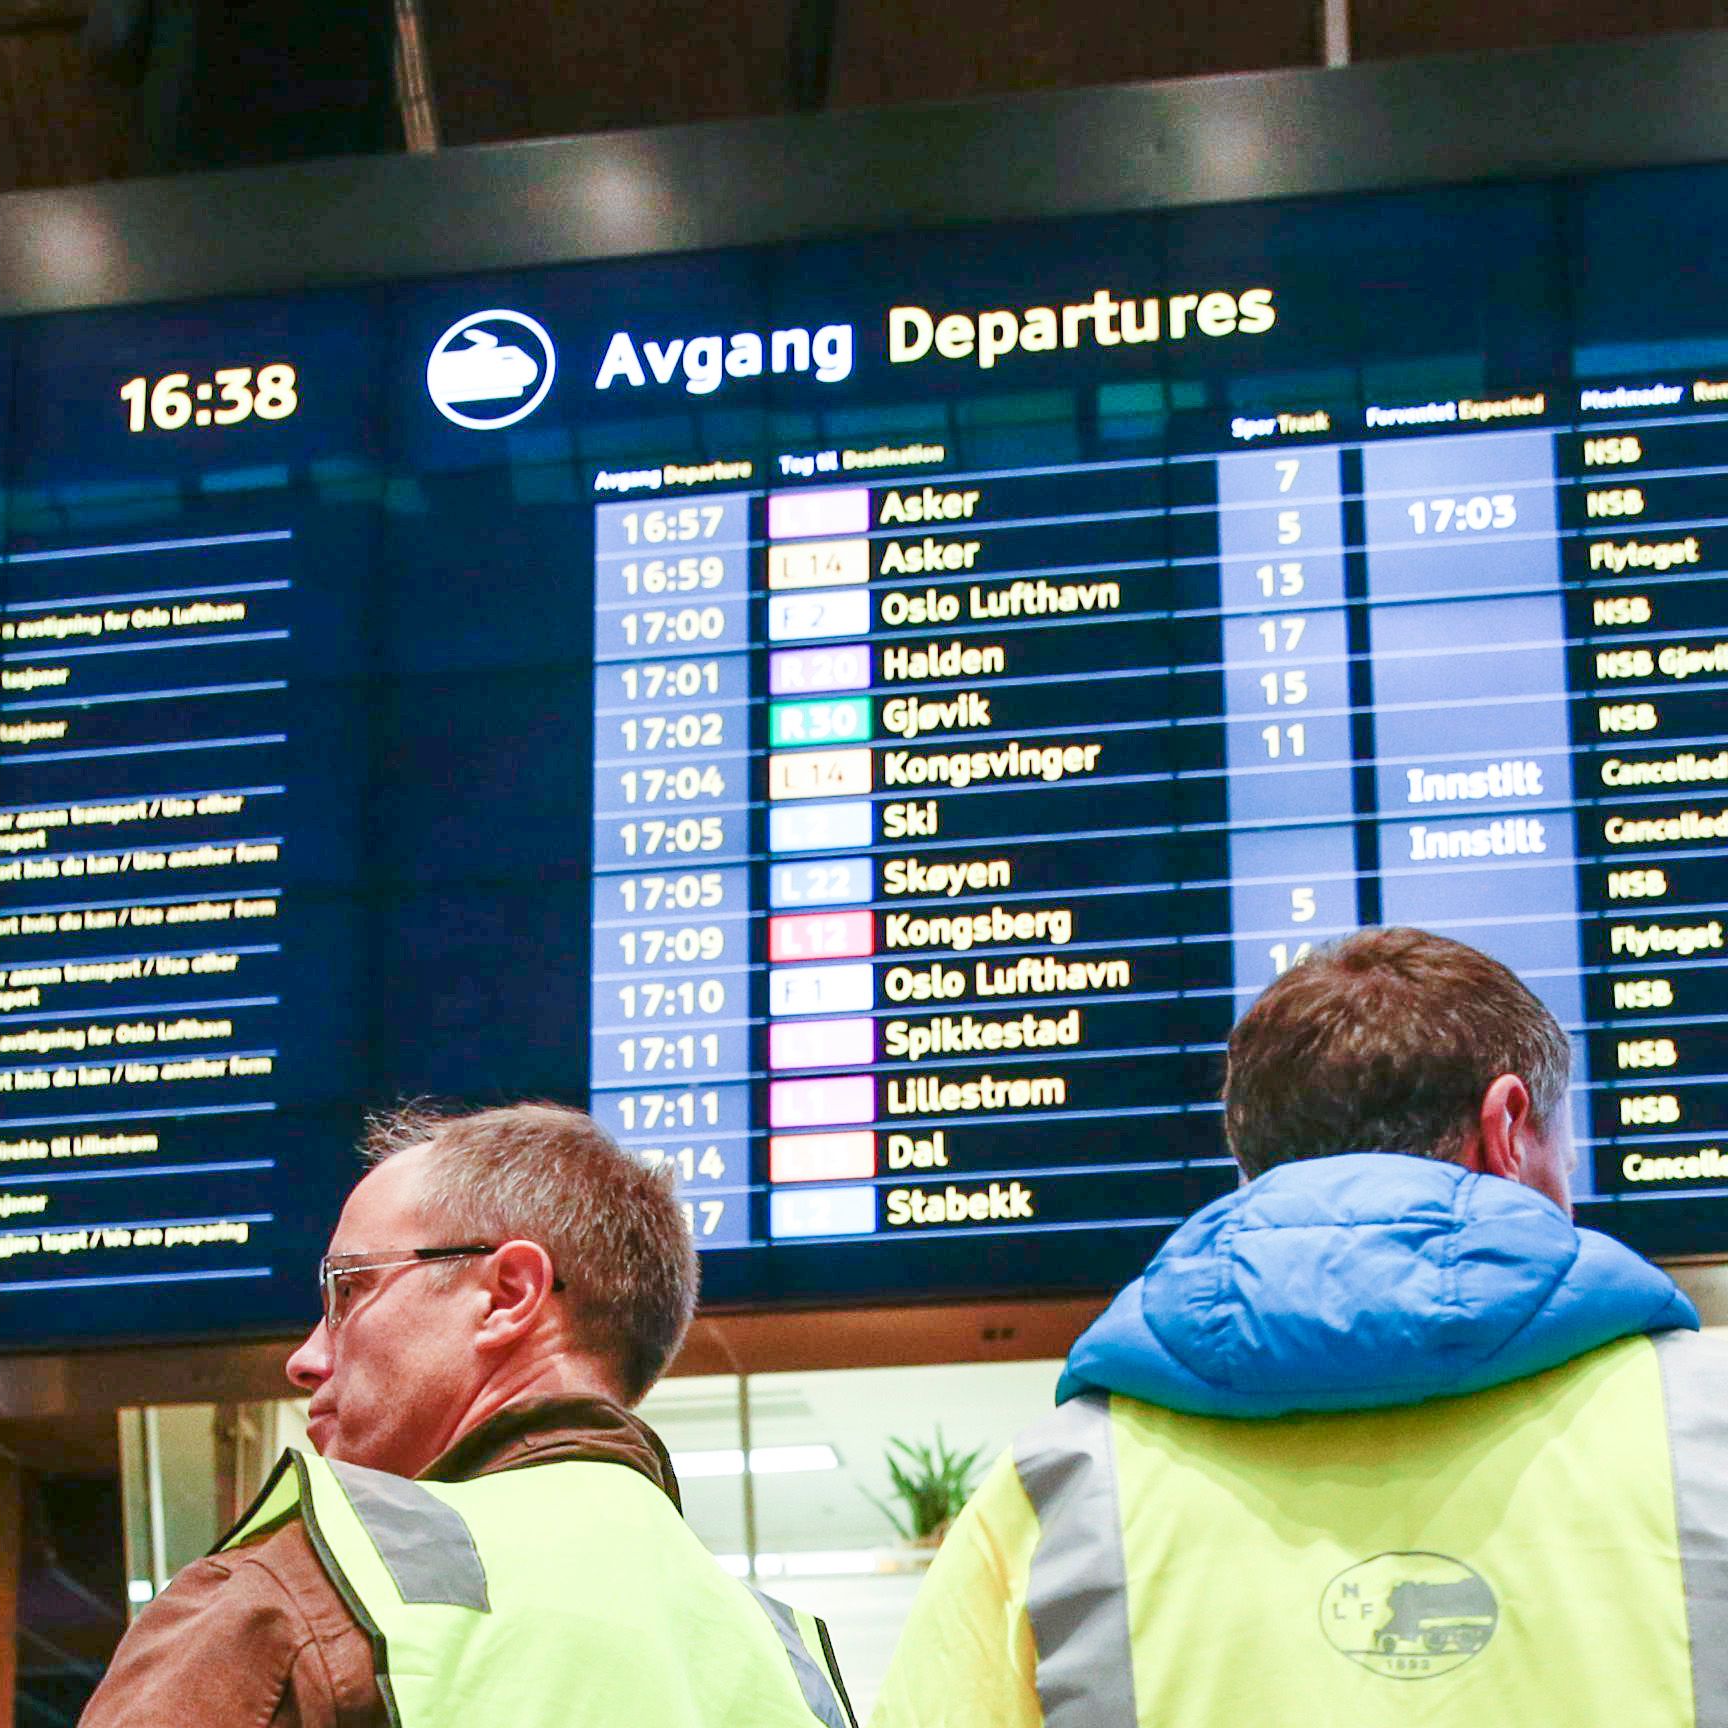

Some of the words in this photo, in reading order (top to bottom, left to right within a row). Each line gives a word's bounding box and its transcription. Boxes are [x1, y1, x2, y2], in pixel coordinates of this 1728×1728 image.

[595, 324, 853, 395] Avgang
[888, 288, 1276, 369] Departures
[120, 363, 298, 433] 16:38
[1583, 436, 1642, 466] NSB
[1274, 459, 1300, 493] 7
[879, 486, 980, 525] Asker
[1406, 491, 1517, 534] 17:03
[1586, 488, 1645, 518] NSB
[622, 505, 724, 545] 16:57
[1278, 510, 1302, 545] 5
[879, 537, 981, 575] Asker
[1589, 536, 1700, 573] Flytoget
[621, 556, 724, 595] 16:59
[1256, 562, 1304, 597] 13
[881, 589, 960, 626] Oslo
[969, 579, 1120, 619] Lufthavn
[1593, 596, 1653, 626] NSB
[621, 606, 725, 645] 17:00
[1258, 617, 1306, 653] 17
[619, 660, 719, 702] 17:01
[883, 642, 1005, 681] Halden
[1595, 649, 1655, 679] NSB
[1260, 669, 1308, 705] 15
[620, 712, 723, 752] 17:02
[882, 692, 992, 741] Gjøvik
[1598, 702, 1658, 733] NSB
[1262, 723, 1305, 758] 11
[882, 739, 1103, 790] Kongsvinger
[1406, 760, 1544, 803] Innstilt
[620, 765, 725, 804] 17:04
[619, 816, 724, 856] 17:05
[883, 800, 938, 838] Ski
[1408, 817, 1547, 861] Innstilt
[619, 872, 724, 913] 17:05
[883, 857, 1011, 897] Skøyen
[1607, 869, 1667, 899] NSB
[1291, 887, 1316, 922] 5
[618, 926, 724, 965] 17:09
[885, 906, 1072, 953] Kongsberg
[1610, 921, 1724, 958] Flytoget
[884, 963, 966, 1002] Oslo
[975, 955, 1130, 996] Lufthavn
[1613, 979, 1674, 1009] NSB
[618, 979, 725, 1019] 17:10
[618, 1033, 718, 1072] 17:11
[882, 1008, 1080, 1061] Spikkestad
[1617, 1038, 1679, 1069] NSB
[617, 1091, 719, 1131] 17:11
[887, 1074, 1066, 1115] Lillestrøm
[1620, 1094, 1681, 1125] NSB
[887, 1130, 949, 1169] Dal
[885, 1180, 1034, 1225] Stabekk
[1342, 1582, 1359, 1598] N
[1332, 1603, 1347, 1620] L
[1360, 1603, 1373, 1620] F
